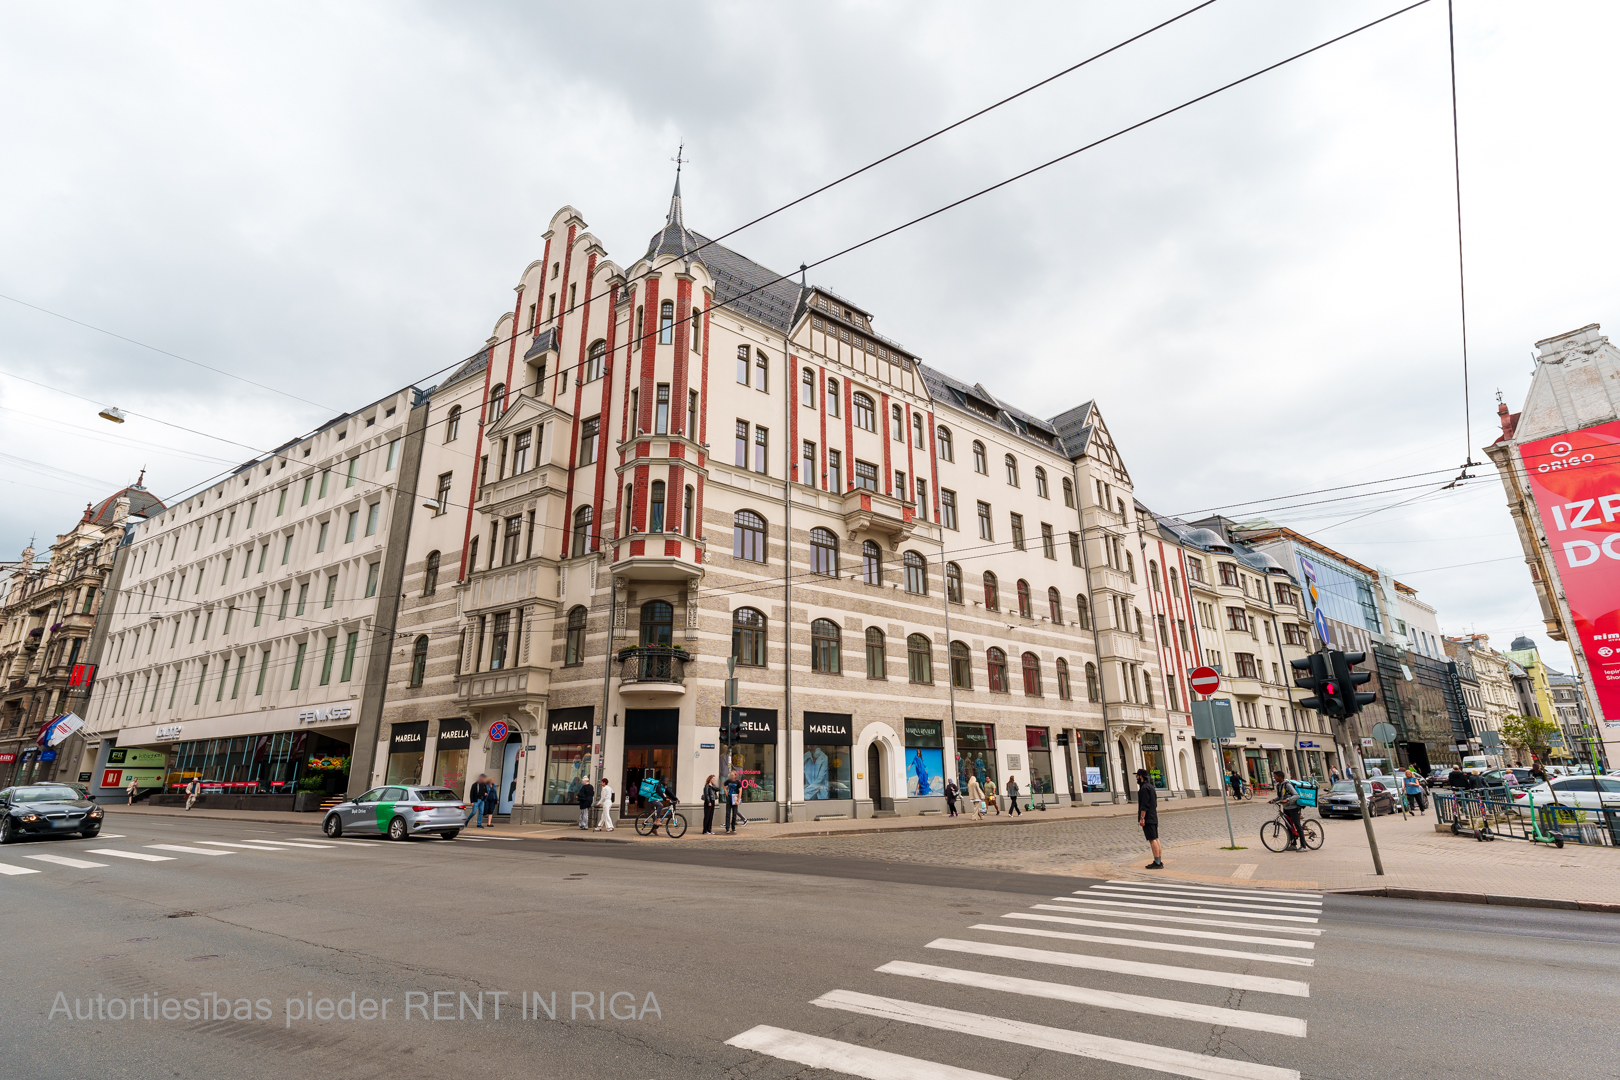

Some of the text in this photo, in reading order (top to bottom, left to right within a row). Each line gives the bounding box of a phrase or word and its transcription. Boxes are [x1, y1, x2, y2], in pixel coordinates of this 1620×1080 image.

[1538, 453, 1595, 473] ORIGO
[297, 706, 351, 723] FENIKSS
[551, 720, 588, 732] MARELLA
[742, 721, 771, 732] RELLA
[809, 724, 847, 735] MARELLA
[395, 733, 421, 743] MARELLA
[440, 729, 469, 740] MARELLA
[444, 779, 459, 788] 30%
[739, 779, 758, 789] 0%
